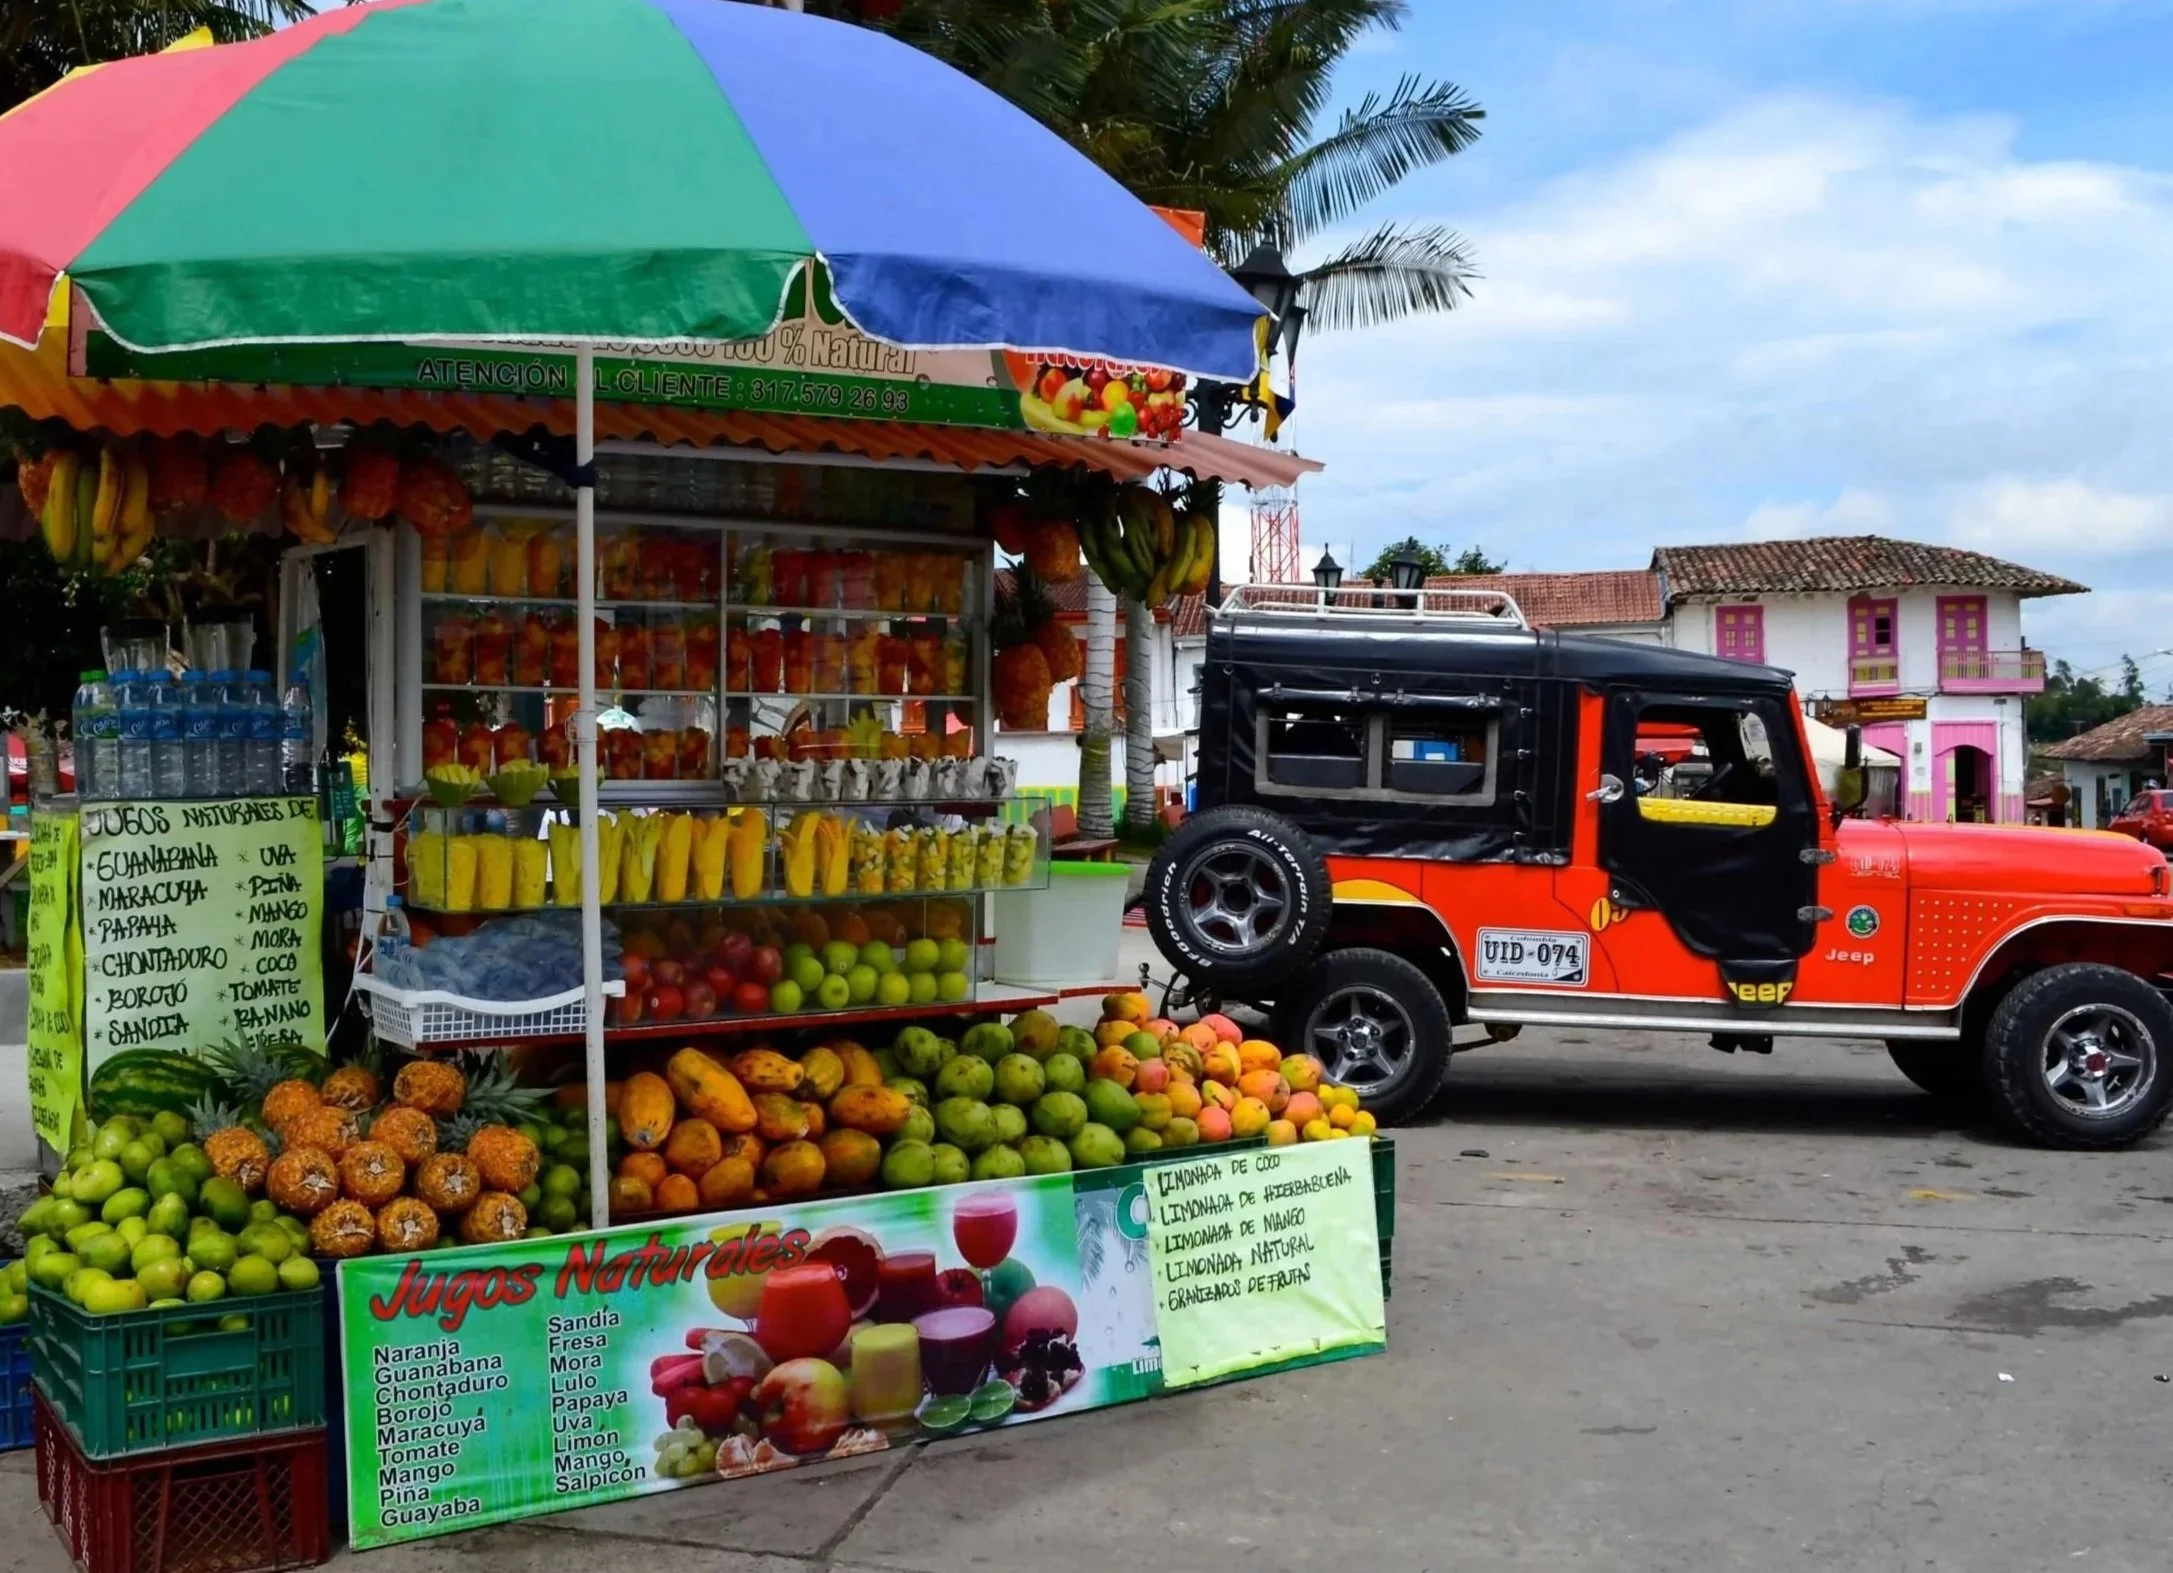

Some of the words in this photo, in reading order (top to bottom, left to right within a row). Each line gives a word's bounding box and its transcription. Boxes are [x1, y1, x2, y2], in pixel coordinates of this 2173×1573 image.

[418, 356, 567, 389] ATENCIÓN
[617, 368, 731, 399] CLIENTE
[750, 379, 796, 402] 317
[800, 383, 843, 408] 579
[848, 387, 876, 411] 26
[882, 390, 910, 413] 93
[86, 805, 171, 836] JUGOS
[182, 801, 284, 828] NATURALES
[287, 799, 315, 820] DE
[97, 842, 219, 882] GUANABANA
[260, 844, 296, 866] UVA
[248, 872, 302, 899] PIÑA
[1247, 829, 1310, 914] All-Terrain
[98, 880, 208, 911] MARACUYA
[248, 900, 308, 924] MANGO
[1160, 861, 1213, 967] BFGoodrich
[98, 914, 177, 943] PAPAYA
[250, 927, 302, 950] MORA
[102, 946, 227, 977] CHONTADURO
[256, 952, 297, 975] COCO
[1825, 948, 1875, 966] Jeep
[105, 978, 188, 1013] BOROJÓ
[228, 979, 301, 1002] TOMATE
[109, 1013, 189, 1045] SANDIA
[233, 1000, 311, 1031] BANANO
[1157, 1164, 1222, 1197] LIMONADA
[1231, 1159, 1248, 1175] DE
[1255, 1154, 1280, 1172] COCO
[1160, 1193, 1234, 1226] LIMONADA
[1239, 1191, 1256, 1208] DE
[1264, 1165, 1352, 1203] HIERBABUENA
[1165, 1222, 1233, 1254] LIMONADA
[1240, 1219, 1255, 1237] DE
[1263, 1207, 1305, 1233] MANGO
[1166, 1251, 1242, 1282] LIMONADA
[1251, 1233, 1315, 1266] NATURAL
[370, 1258, 545, 1332] Jugos
[553, 1223, 811, 1299] Naturales
[1168, 1279, 1240, 1311] GRANIZADOS
[548, 1305, 620, 1334] Sandía
[374, 1339, 460, 1365] Naranja
[549, 1334, 607, 1353] Fresa
[375, 1355, 502, 1385] Guanabana
[550, 1355, 602, 1373] Mora
[376, 1374, 508, 1405] Chontaduro
[551, 1373, 597, 1393] Lulo
[377, 1396, 453, 1426] Borojó
[552, 1390, 628, 1414] Papaya
[378, 1407, 486, 1446] Maracuyá
[553, 1416, 592, 1433] Uva
[554, 1424, 619, 1453] Limón
[377, 1441, 460, 1465] Tomate
[555, 1451, 625, 1473] Mango
[380, 1463, 455, 1487] Mango
[556, 1458, 646, 1493] Salpicón
[380, 1485, 430, 1507] Piña
[382, 1498, 480, 1527] Guayaba
